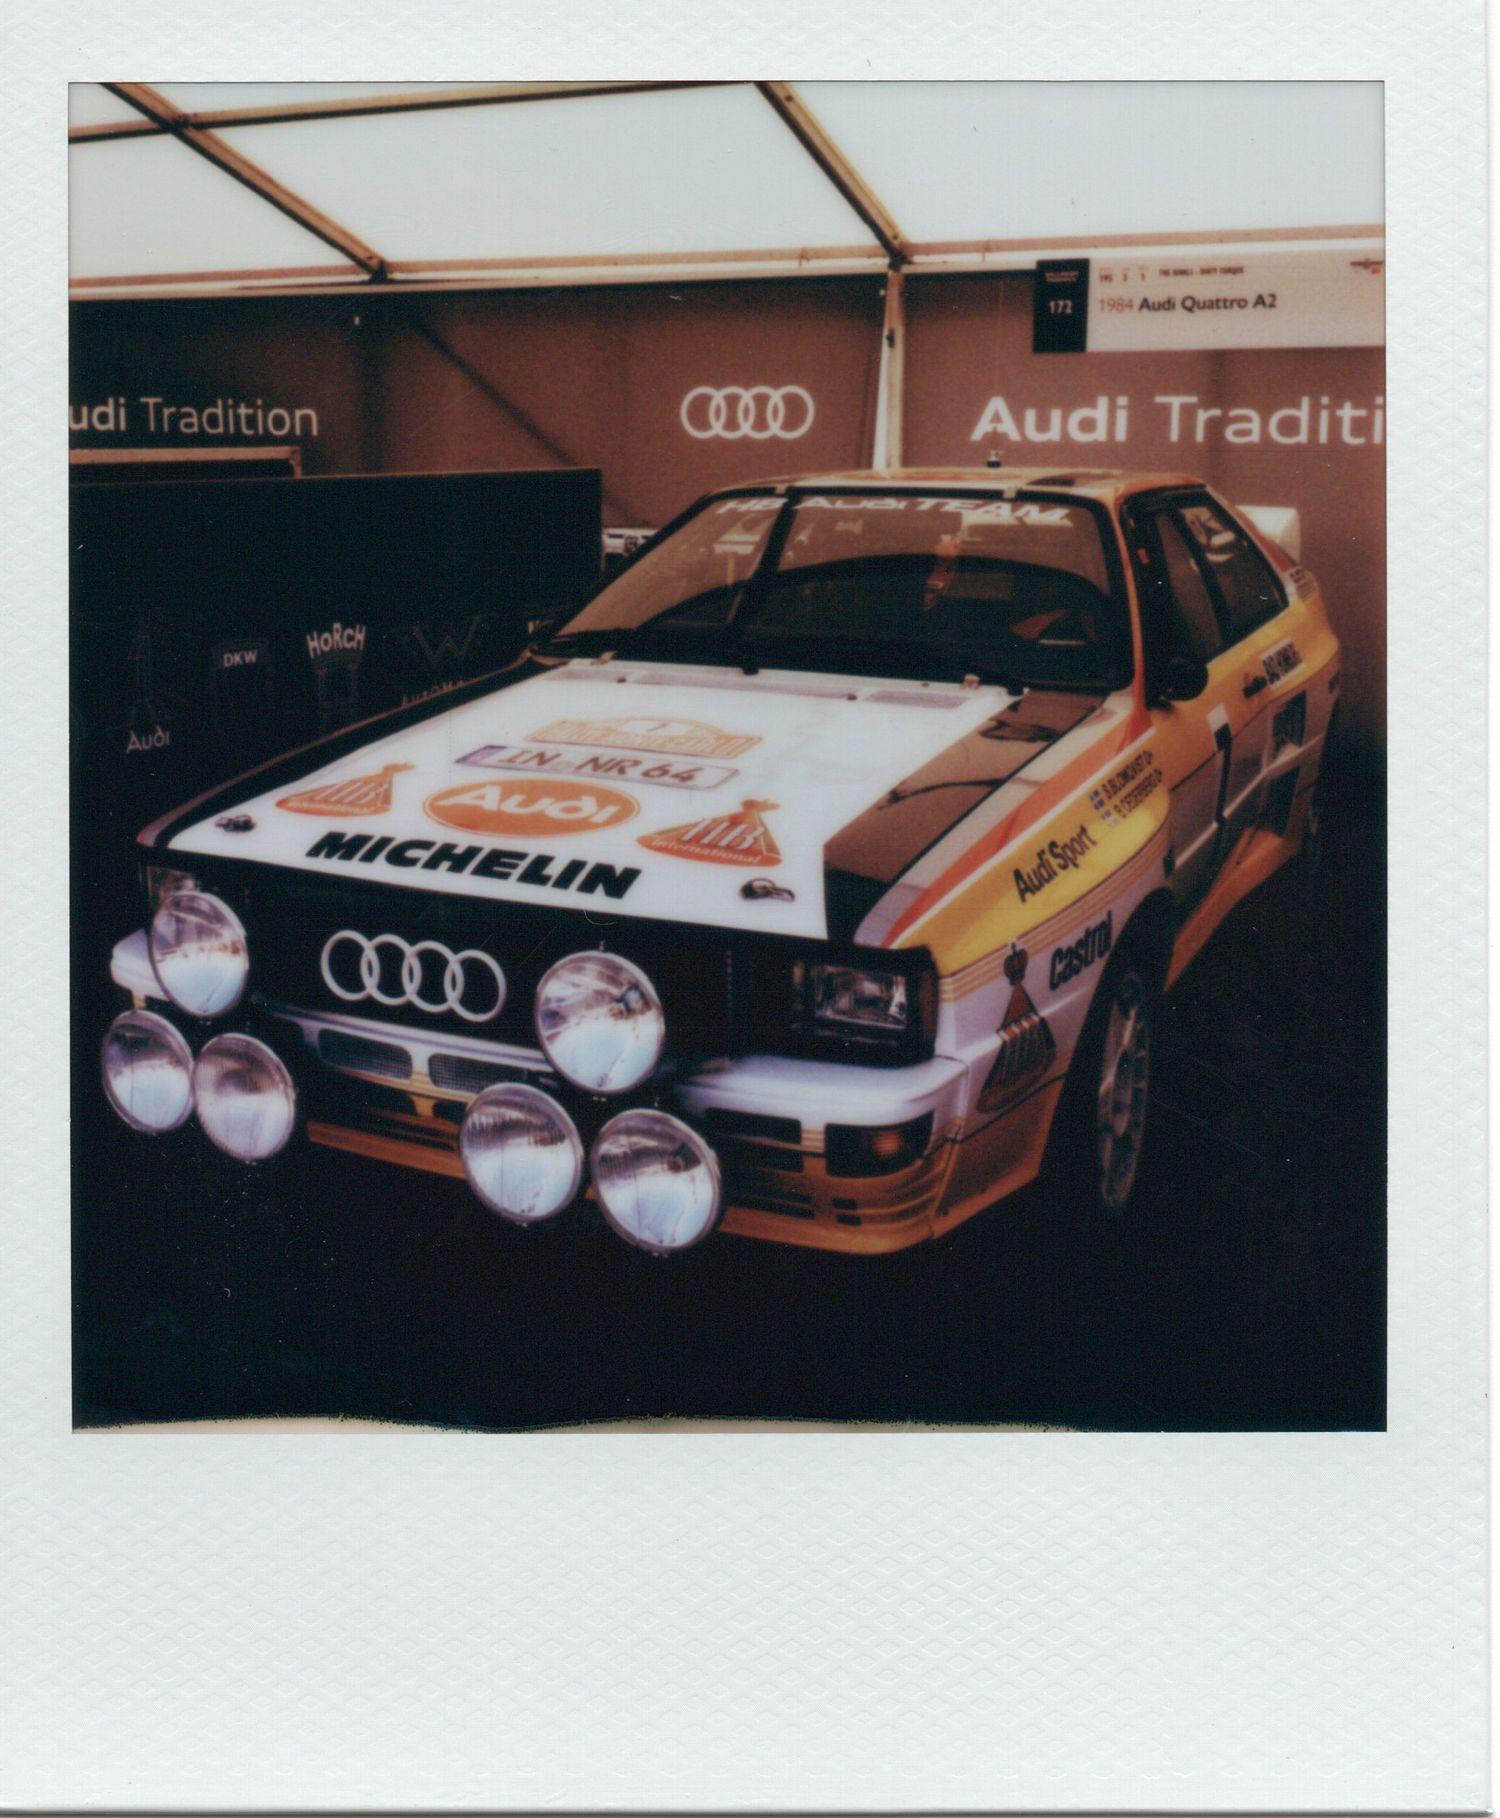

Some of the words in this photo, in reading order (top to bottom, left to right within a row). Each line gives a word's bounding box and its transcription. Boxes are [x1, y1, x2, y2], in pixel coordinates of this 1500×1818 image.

[1049, 300, 1073, 315] 172
[1100, 299, 1133, 313] 1984
[1138, 297, 1177, 313] Audi
[1181, 295, 1249, 313] Quattro
[1252, 293, 1278, 309] A2
[139, 397, 319, 437] Tradition
[969, 395, 1130, 443] Audi
[1153, 395, 1384, 445] Traditi
[715, 498, 789, 515] HB
[913, 497, 1072, 522] TEAM
[222, 649, 258, 668] DKW
[125, 724, 171, 755] Audi
[503, 749, 561, 767] IN
[572, 754, 642, 776] NR
[643, 763, 702, 783] 64
[436, 783, 625, 824] Audi
[680, 816, 765, 850] HB
[305, 831, 643, 900] MICHELIN
[1011, 844, 1056, 903] Audi
[1048, 823, 1099, 870] Sport
[1048, 908, 1113, 992] Castrol
